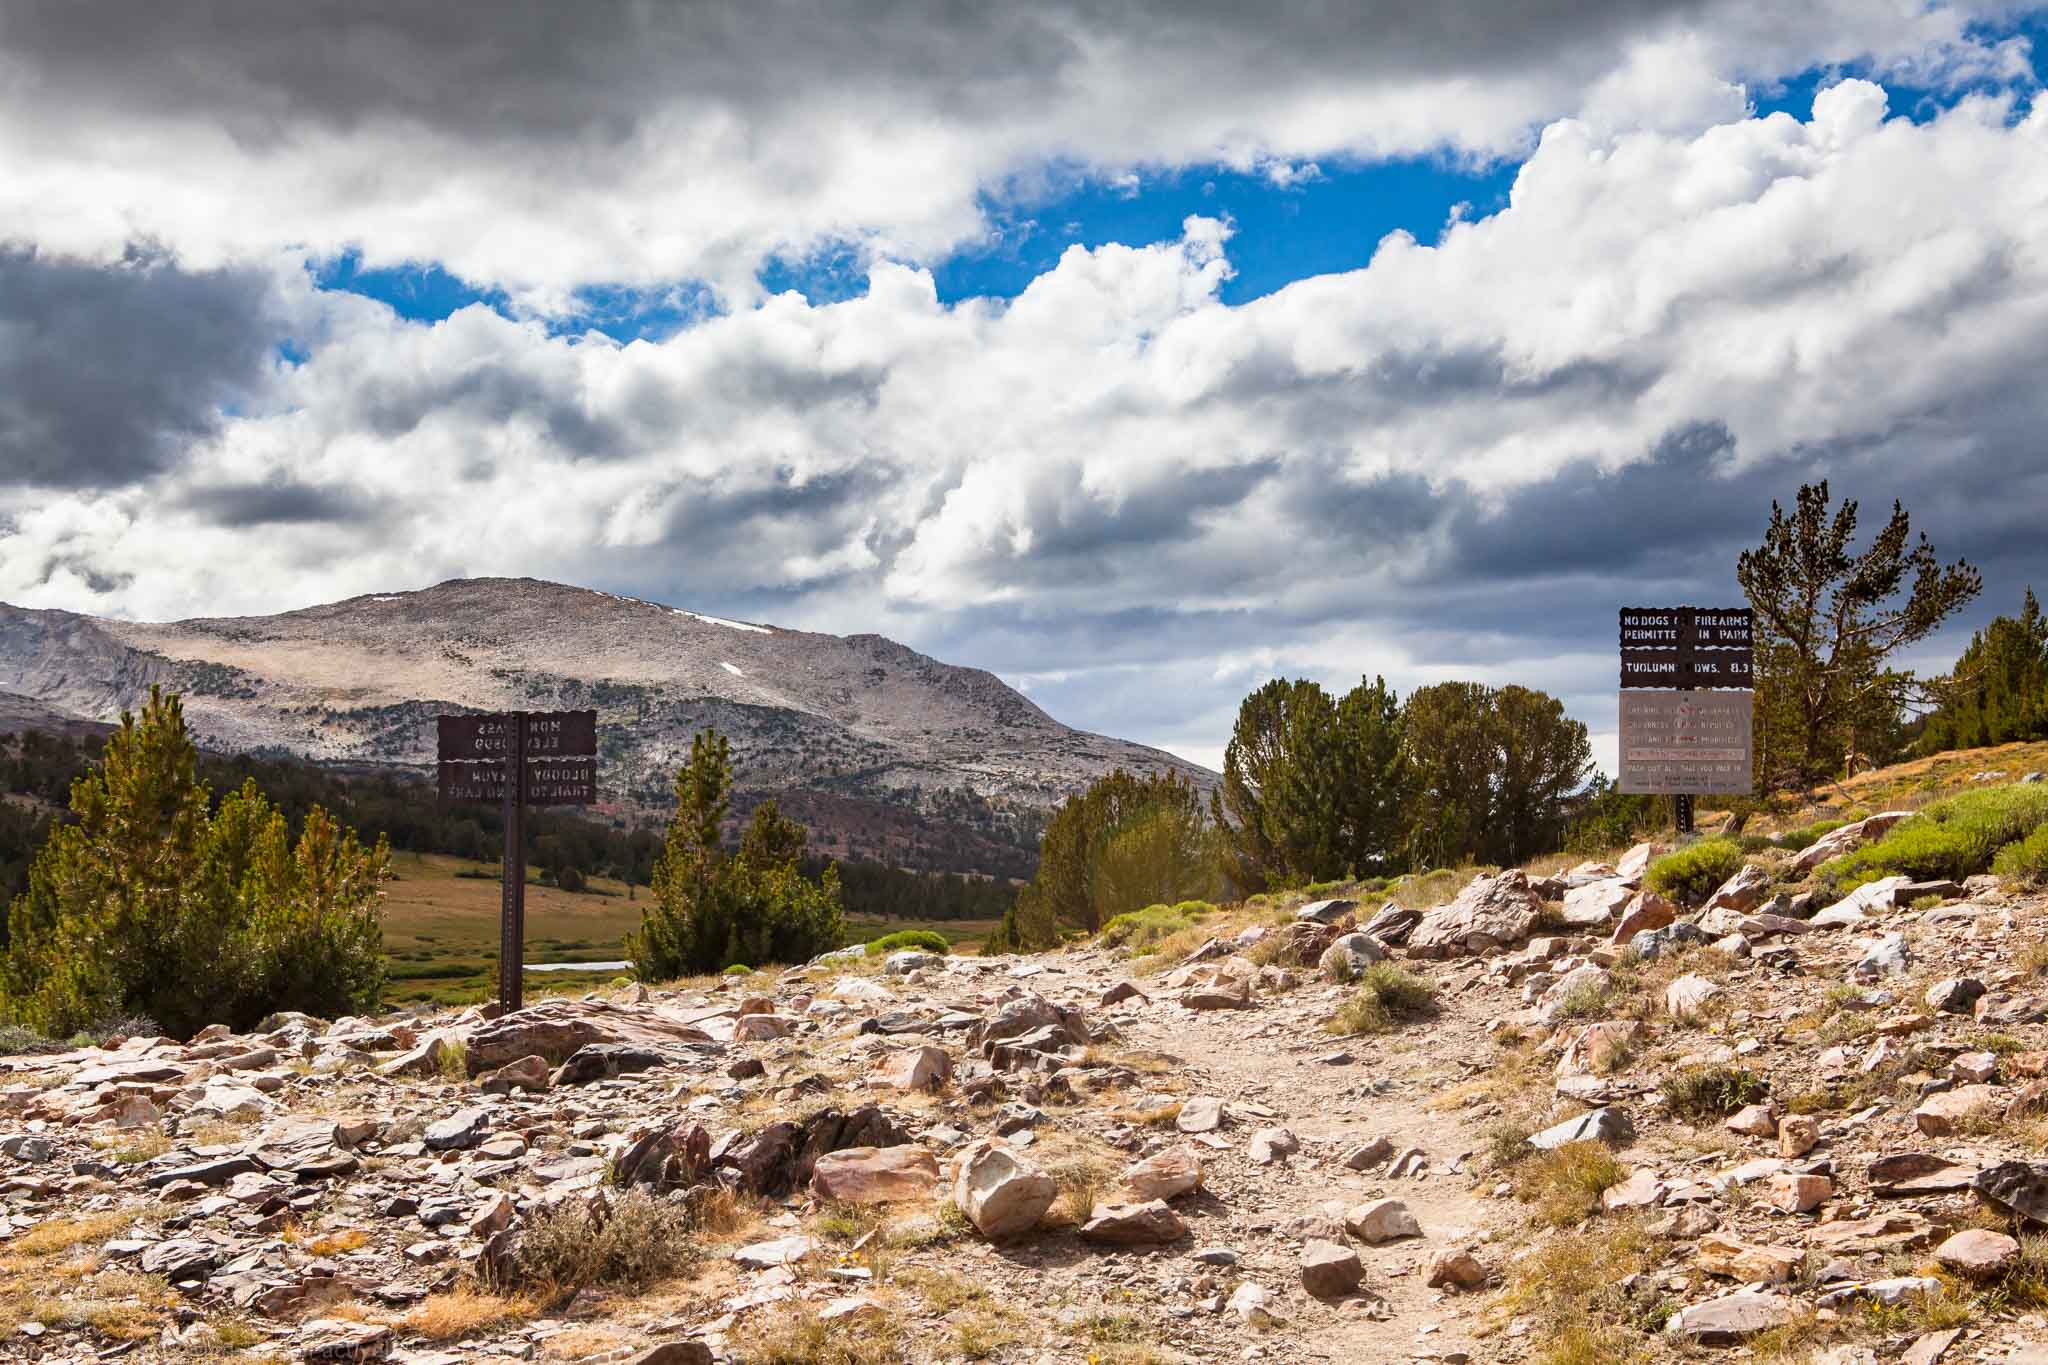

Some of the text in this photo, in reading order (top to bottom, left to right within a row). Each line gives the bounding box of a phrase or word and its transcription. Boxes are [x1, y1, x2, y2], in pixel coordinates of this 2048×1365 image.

[1624, 616, 1639, 626] NO
[1641, 616, 1669, 626] DOGS
[1695, 616, 1749, 626] FIREARMS
[1624, 630, 1748, 640] PERMITTE IN PARK
[1626, 663, 1749, 674] TUOLUMN DWS. 8.3
